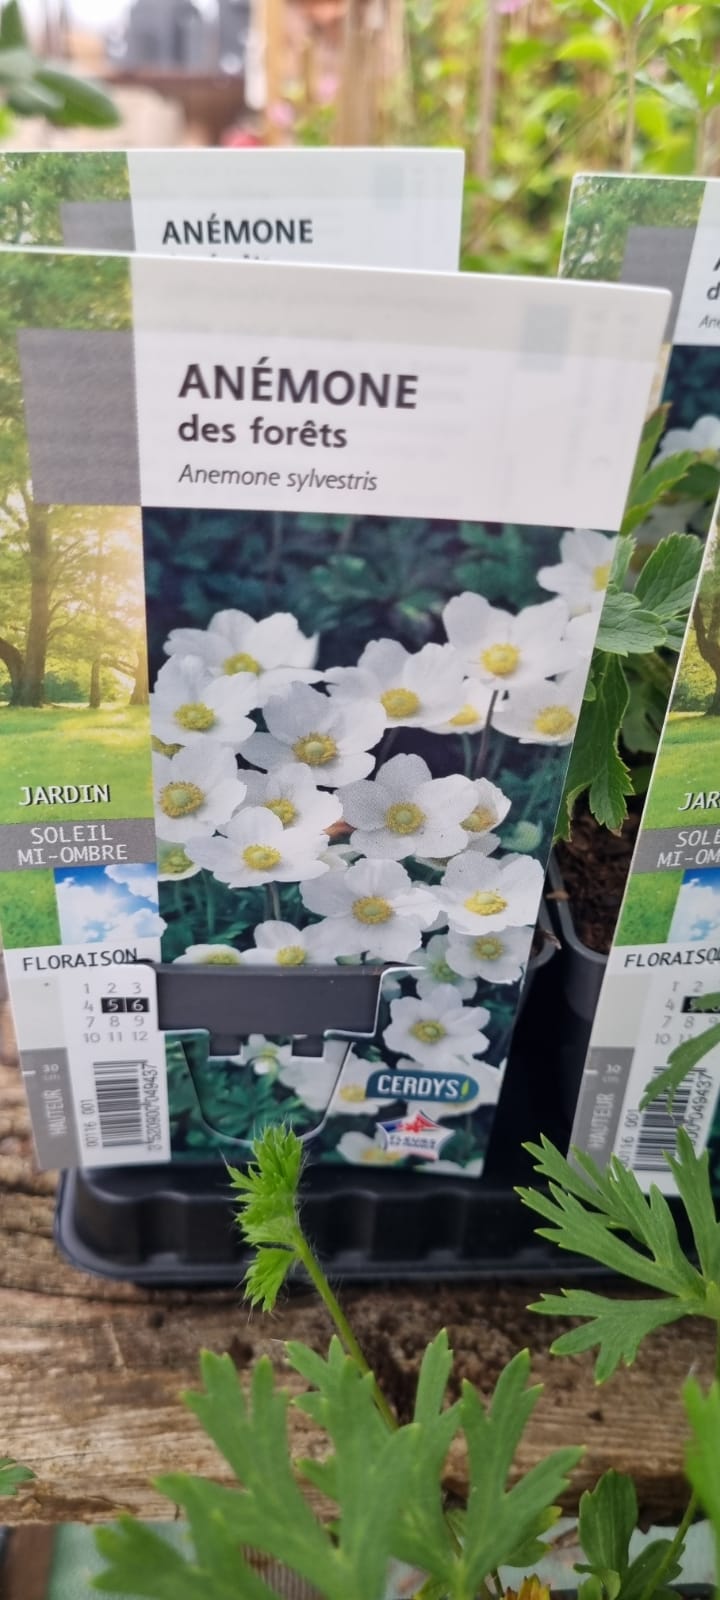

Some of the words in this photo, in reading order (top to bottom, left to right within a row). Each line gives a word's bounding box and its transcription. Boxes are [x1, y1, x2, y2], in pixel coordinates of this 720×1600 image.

[162, 212, 313, 245] ANÉMONE
[177, 356, 419, 410] ANÉMONE
[178, 413, 237, 443] des
[250, 416, 348, 449] forêts
[178, 463, 281, 487] Anemone
[287, 468, 378, 492] sylvestris
[18, 783, 111, 806] JARDIN
[30, 824, 114, 845] SOLEIL
[17, 844, 128, 866] MI-OMBRE
[23, 947, 138, 971] FLORAISON
[83, 983, 90, 994] 1
[107, 982, 117, 994] 2
[132, 982, 142, 994] 3
[672, 980, 679, 992] 1
[693, 980, 703, 993] 2
[83, 1001, 94, 1012] 4
[108, 999, 119, 1012] 5
[132, 998, 144, 1011] 6
[665, 998, 674, 1011] 4
[86, 1016, 96, 1028] 7
[110, 1015, 120, 1027] 8
[134, 1015, 145, 1027] 9
[662, 1015, 672, 1028] 7
[684, 1015, 695, 1028] 8
[83, 1033, 101, 1043] 10
[109, 1032, 123, 1042] 11
[132, 1031, 148, 1042] 12
[655, 1033, 671, 1044] 10
[377, 1075, 460, 1099] CERDYS
[44, 1089, 67, 1136] HAUTEUR
[588, 1093, 615, 1150] HAUTEUR
